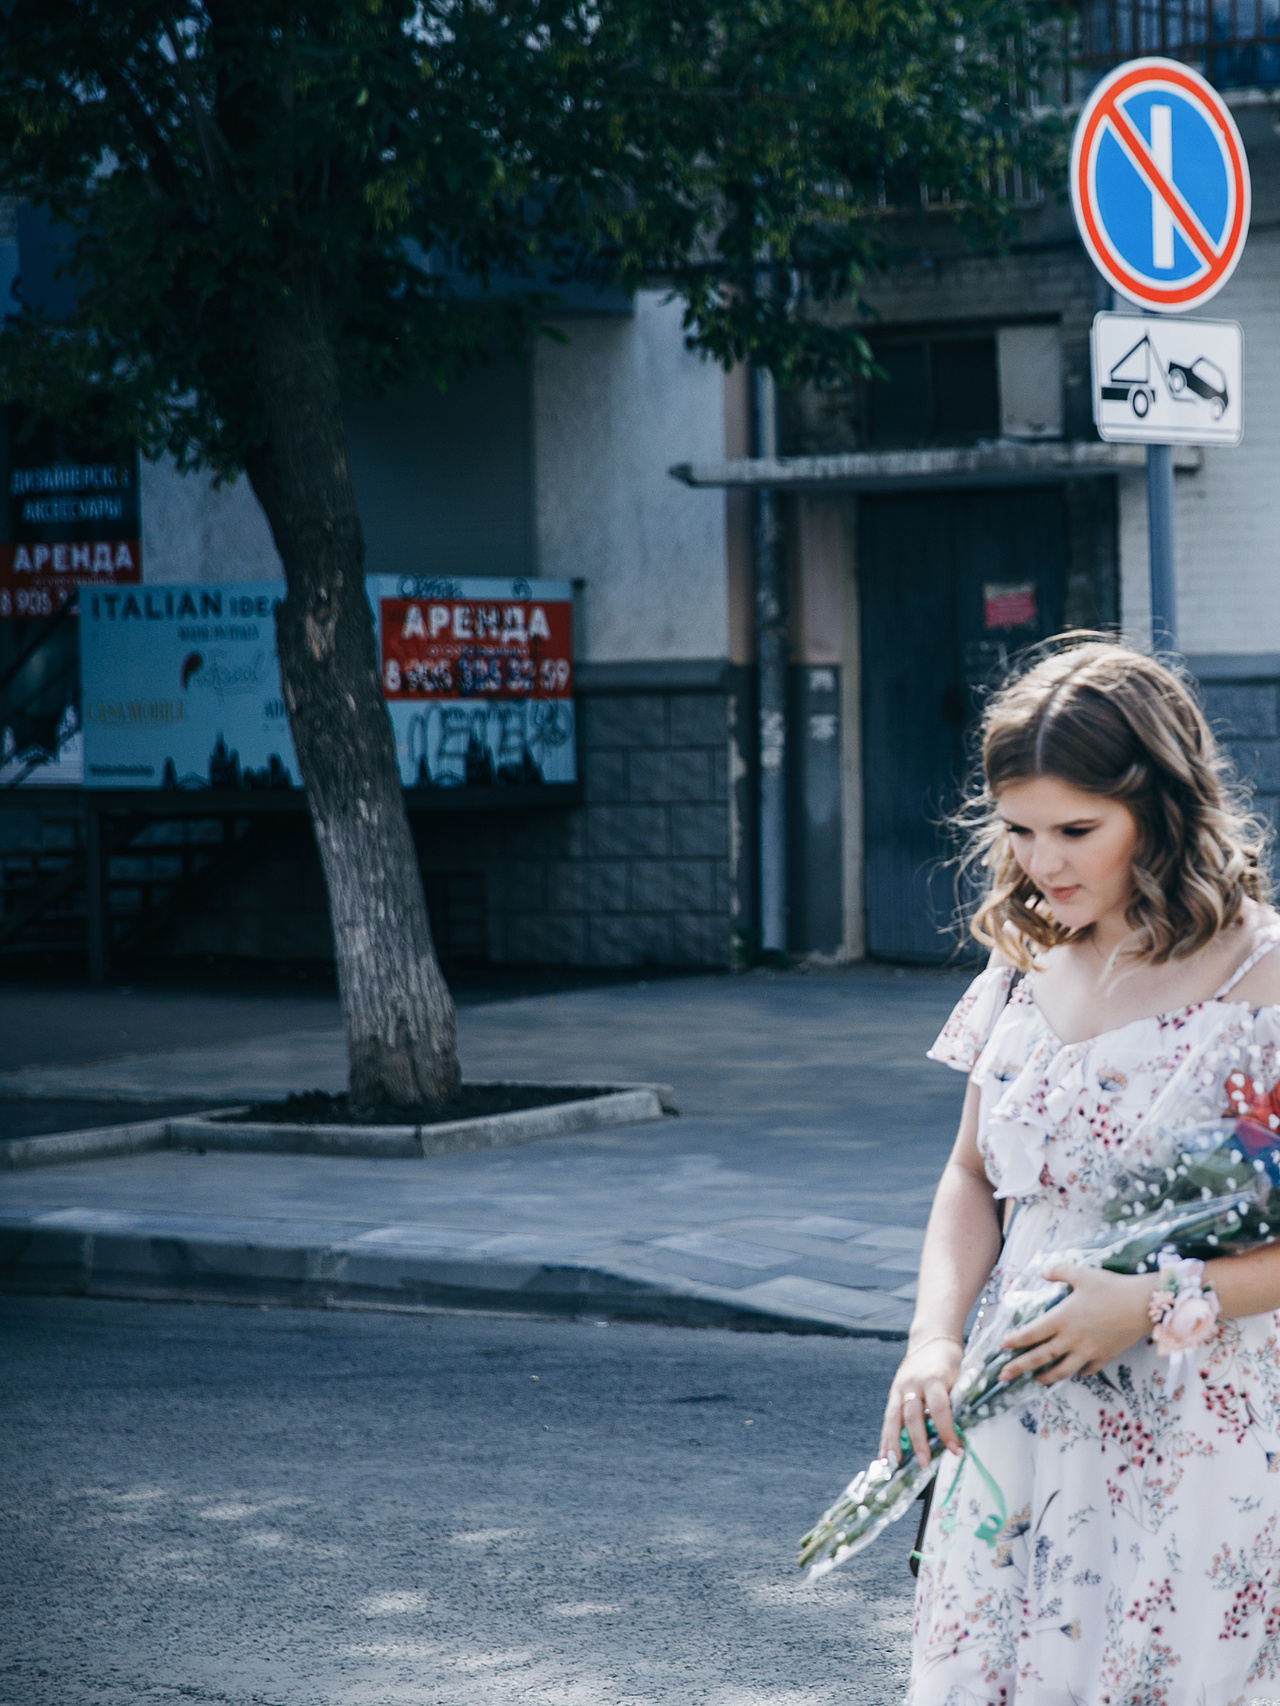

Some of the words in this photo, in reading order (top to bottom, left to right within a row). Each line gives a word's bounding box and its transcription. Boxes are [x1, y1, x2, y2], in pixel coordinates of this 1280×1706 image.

[13, 541, 134, 574] АРЕНДА
[91, 590, 223, 621] ITALIAN
[402, 603, 552, 644] АРЕНДА
[384, 658, 401, 693] 8
